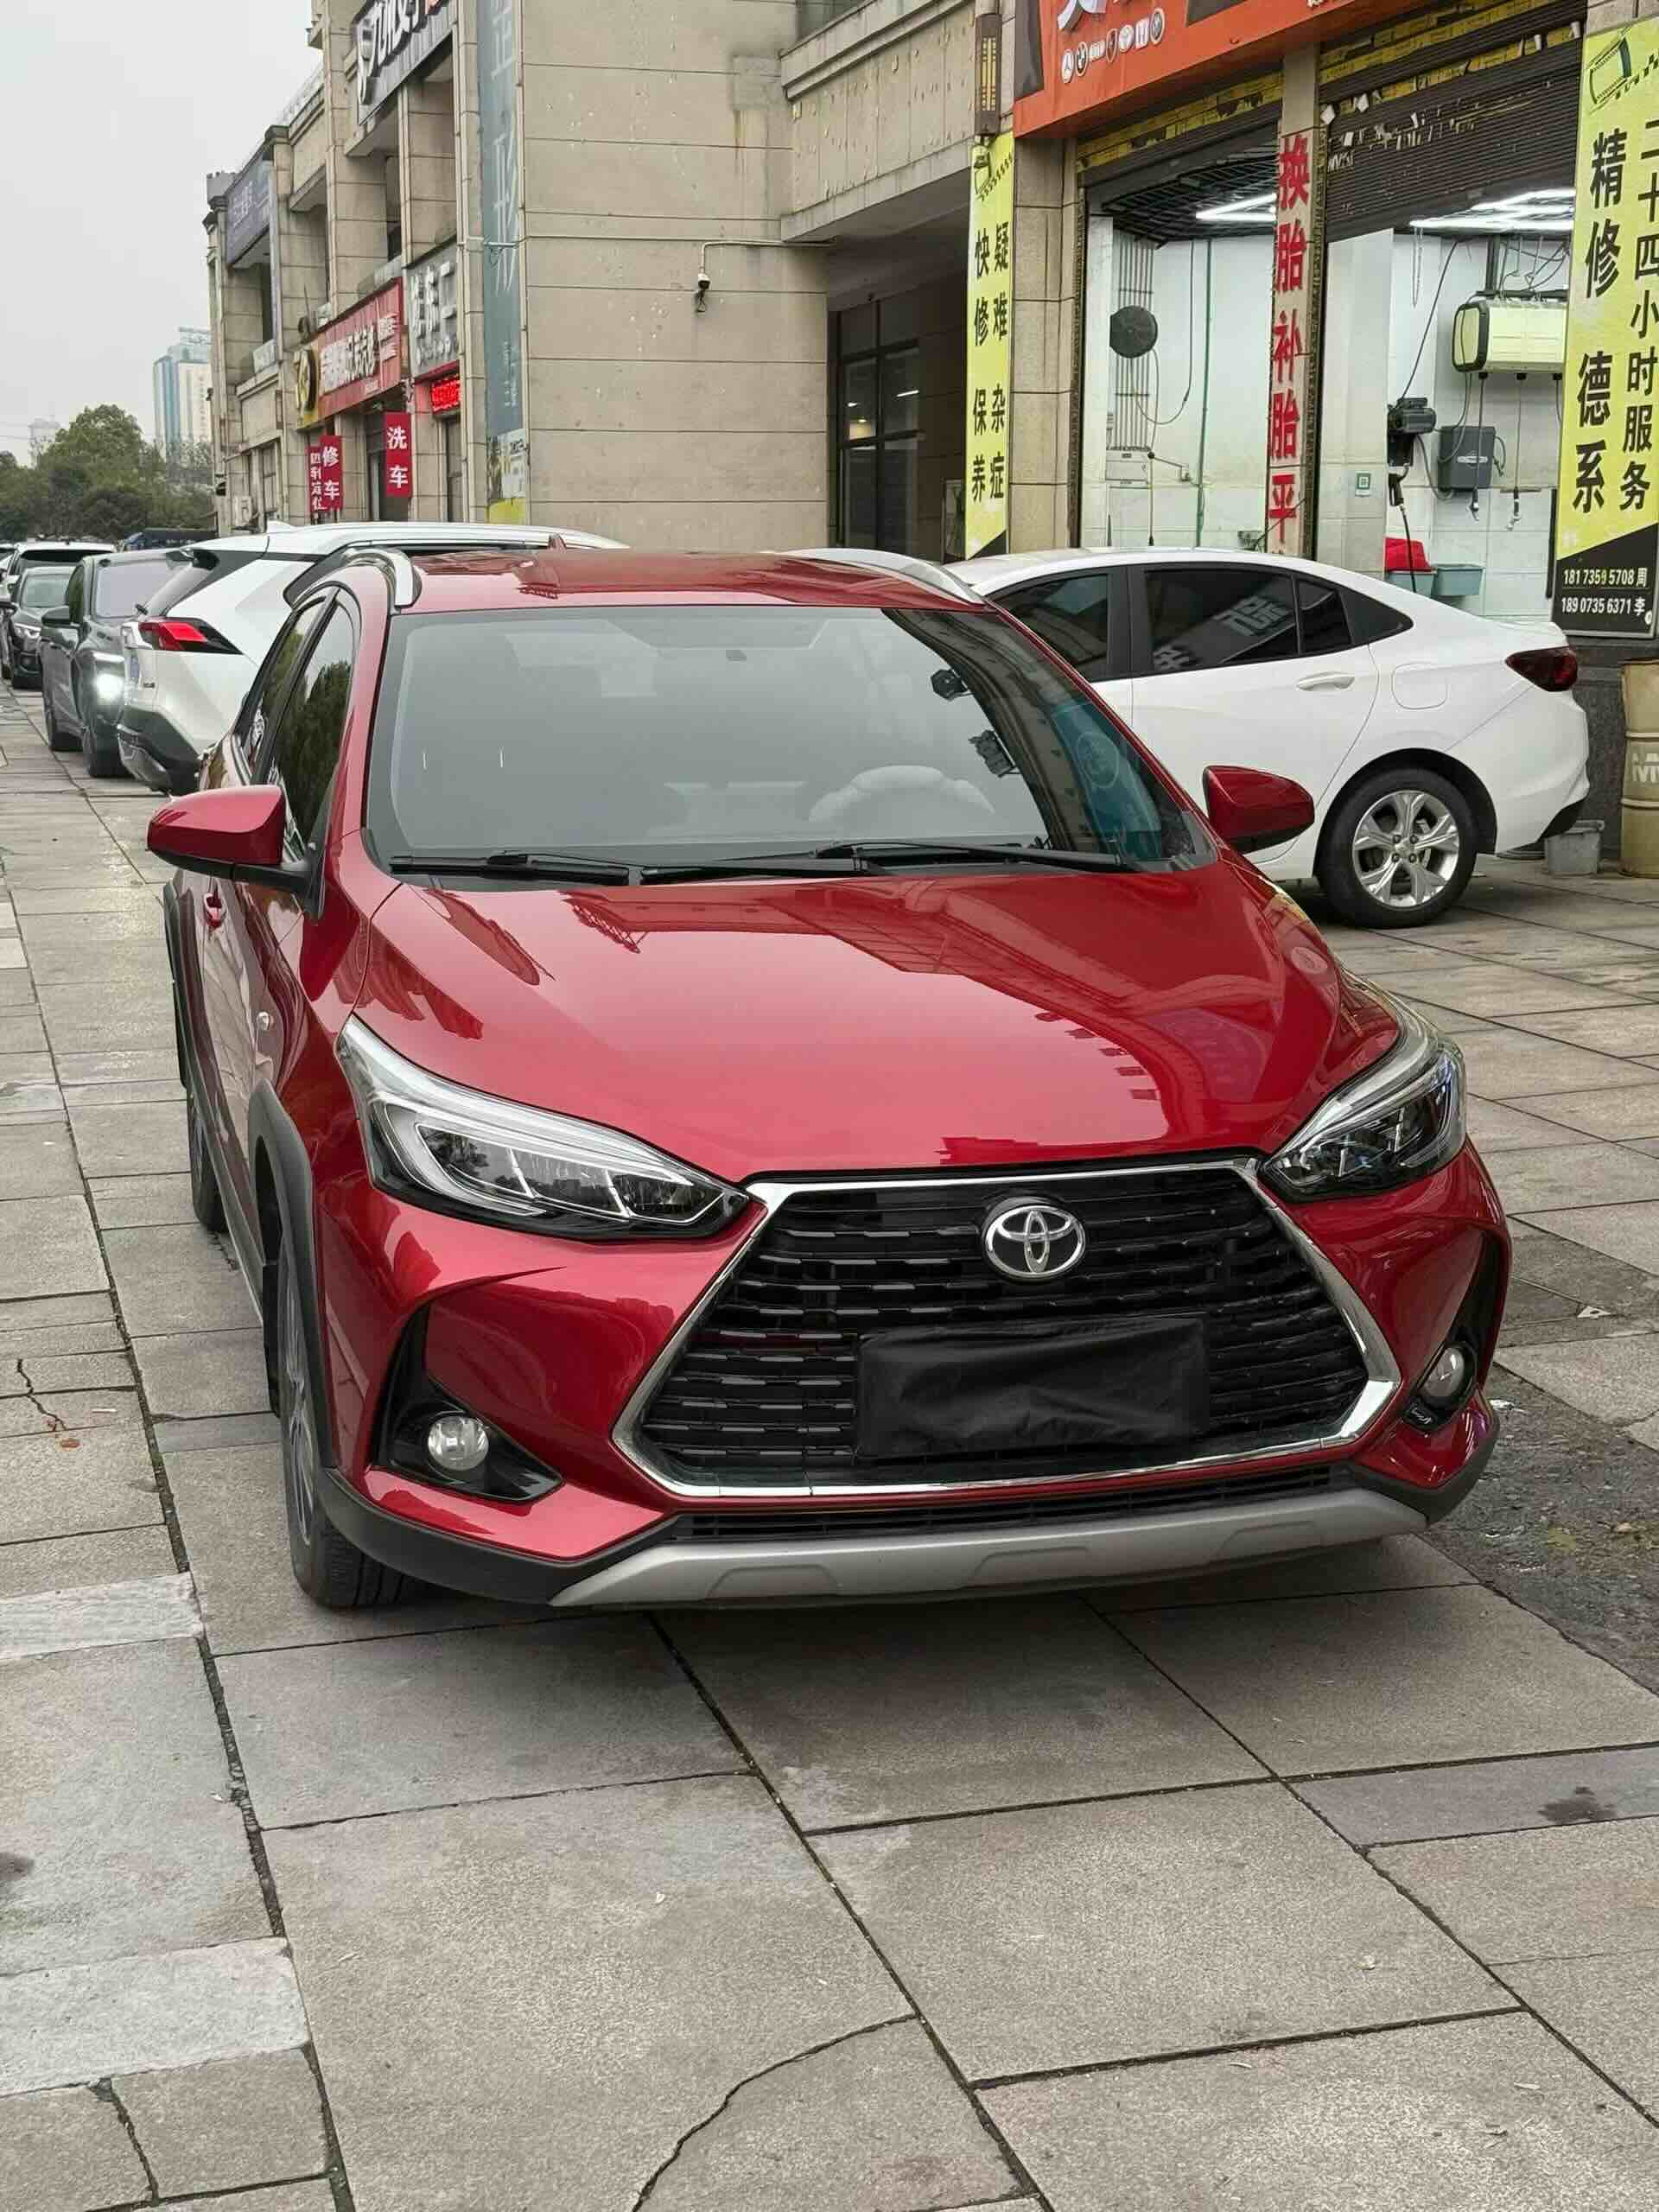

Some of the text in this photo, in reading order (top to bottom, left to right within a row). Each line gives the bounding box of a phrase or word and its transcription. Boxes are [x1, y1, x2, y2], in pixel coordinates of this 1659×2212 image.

[1268, 134, 1309, 553] 换胎补胎平
[1573, 128, 1628, 513] 精修 德系
[1620, 119, 1659, 512] 二十四小时服务
[322, 446, 340, 500] 修车
[386, 425, 409, 489] 洗车
[1561, 596, 1645, 616] 189 0735 6371 李
[1564, 569, 1580, 585] 181
[1608, 569, 1635, 585] 5708
[1636, 567, 1648, 587] 周
